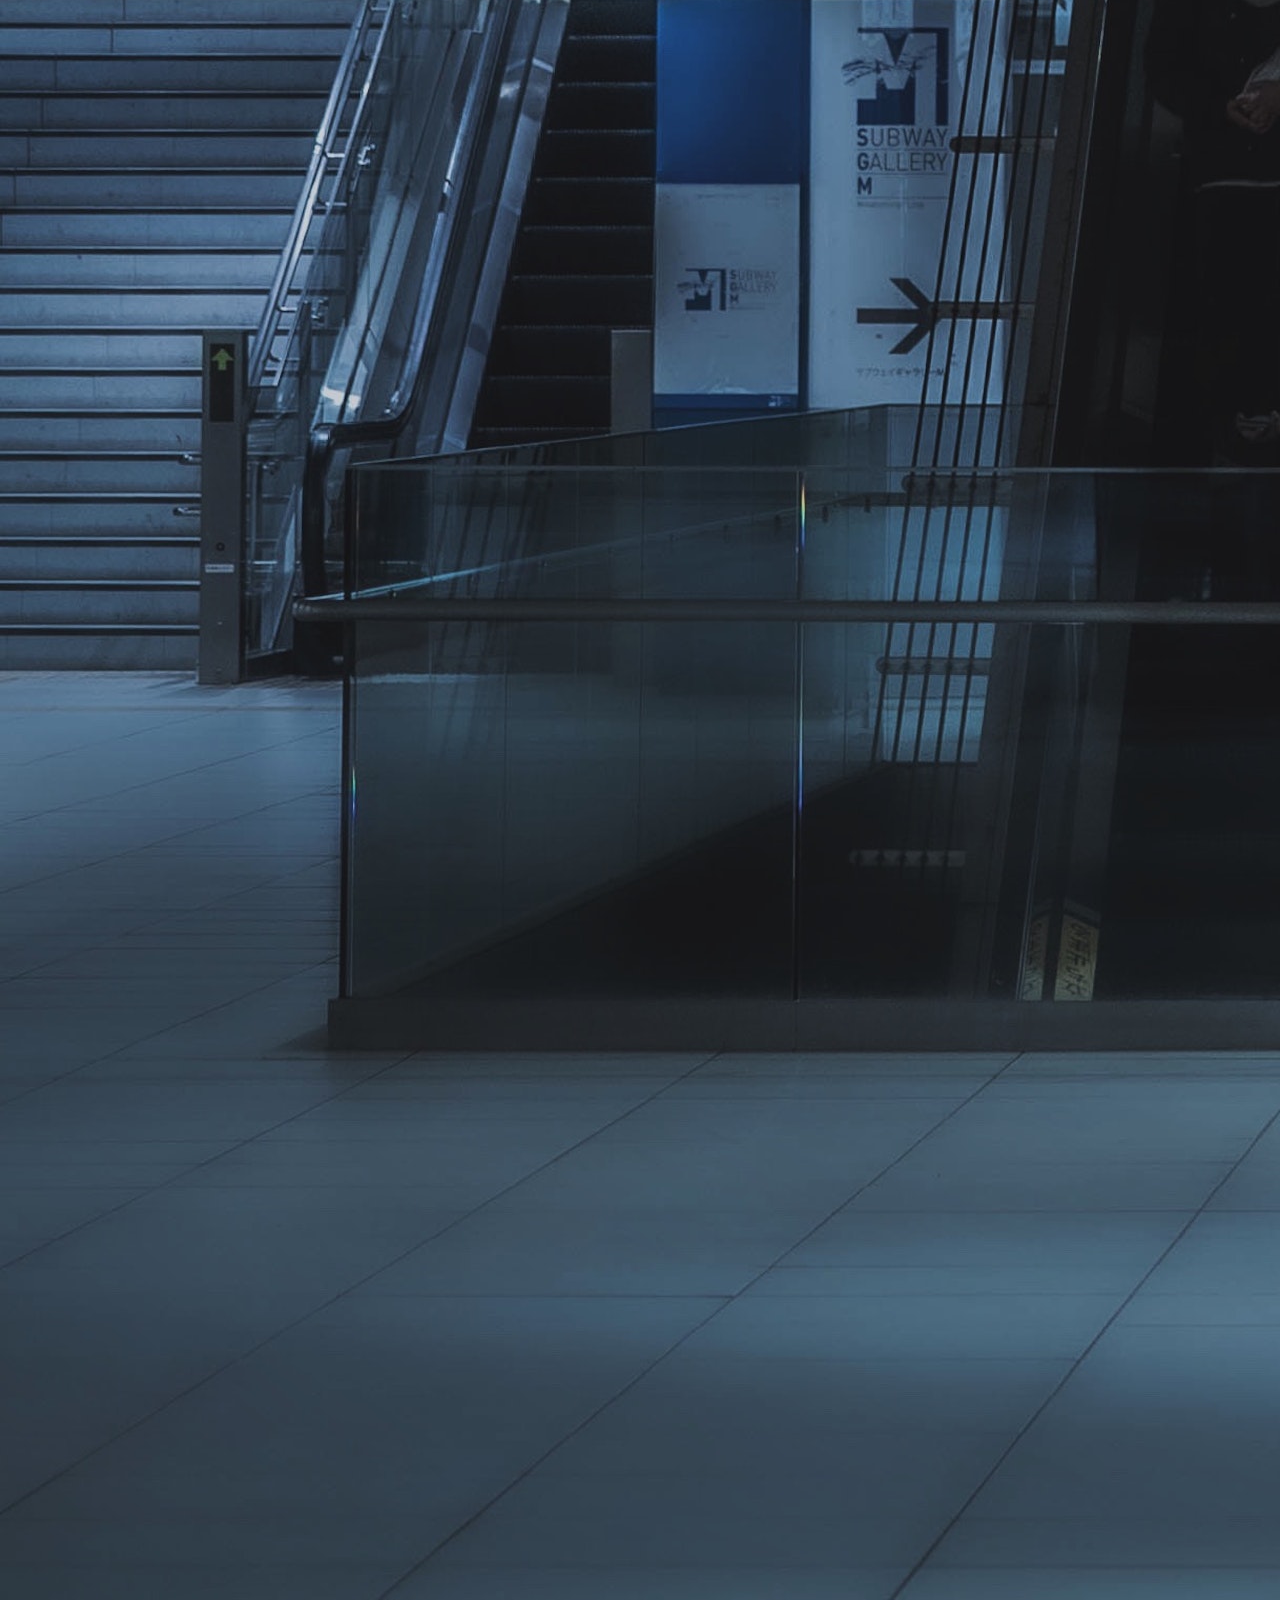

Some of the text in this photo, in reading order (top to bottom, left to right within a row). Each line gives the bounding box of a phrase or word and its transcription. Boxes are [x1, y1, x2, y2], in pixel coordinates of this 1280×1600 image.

[857, 128, 948, 148] SUBWAY
[857, 152, 948, 172] GALLERY
[857, 177, 872, 195] M
[729, 269, 777, 280] SUBWAY
[729, 282, 777, 294] GALLERY
